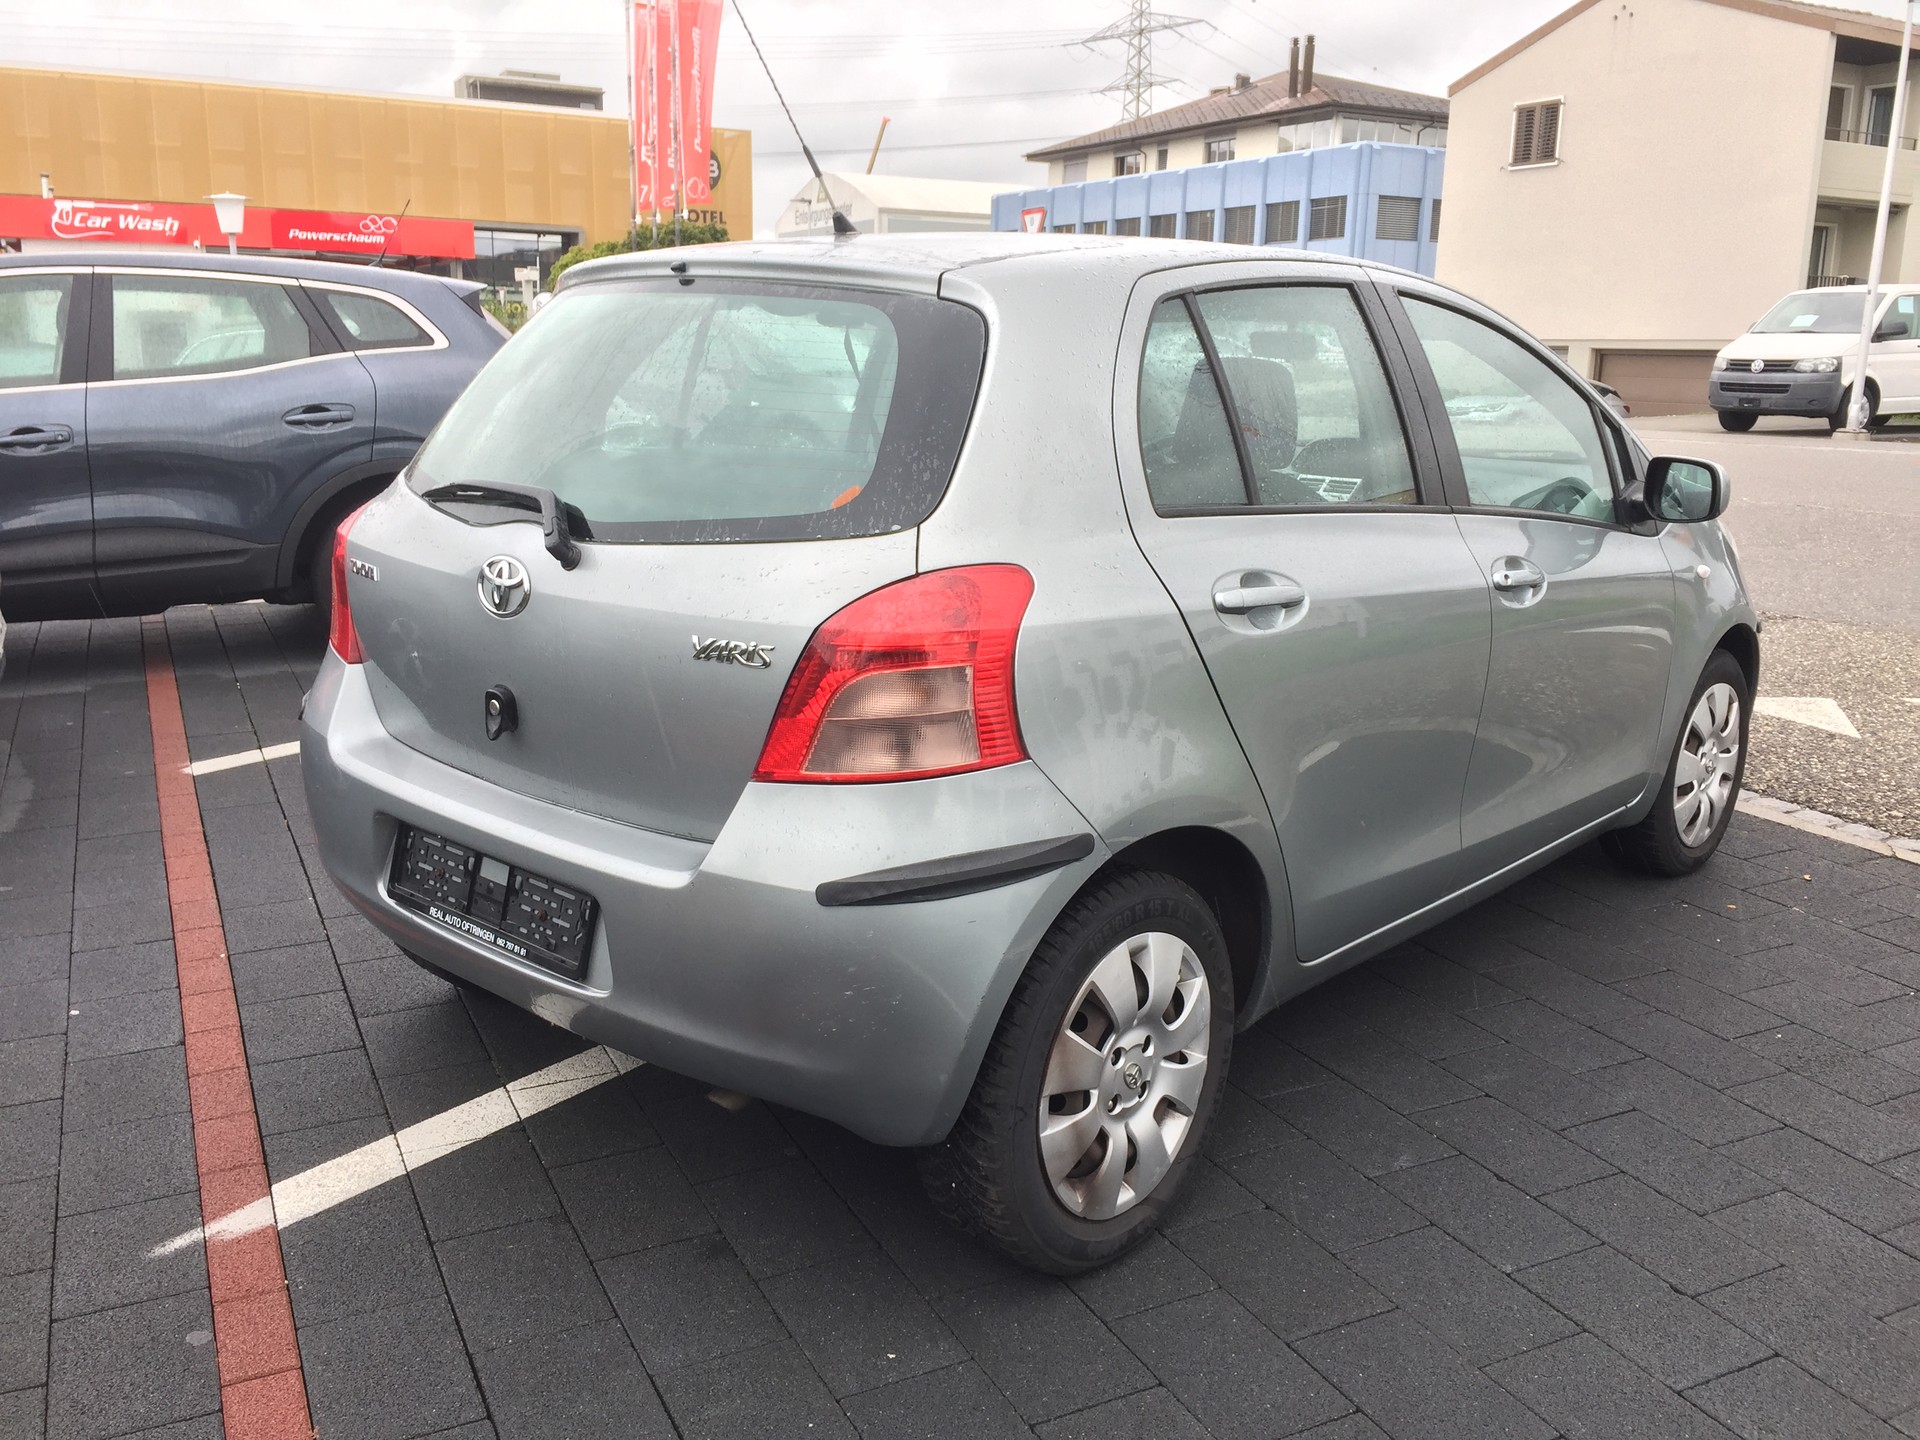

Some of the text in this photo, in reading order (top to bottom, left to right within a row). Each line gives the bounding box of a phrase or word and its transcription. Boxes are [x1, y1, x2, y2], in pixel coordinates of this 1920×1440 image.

[73, 211, 180, 232] Car Wash
[288, 228, 385, 244] Powerschaum
[429, 906, 444, 921] REAL
[444, 913, 462, 928] AUTO
[461, 920, 496, 943] OFTRINGEN
[1088, 910, 1133, 954] 185/60
[1135, 904, 1145, 921] R
[1148, 899, 1162, 916] 15
